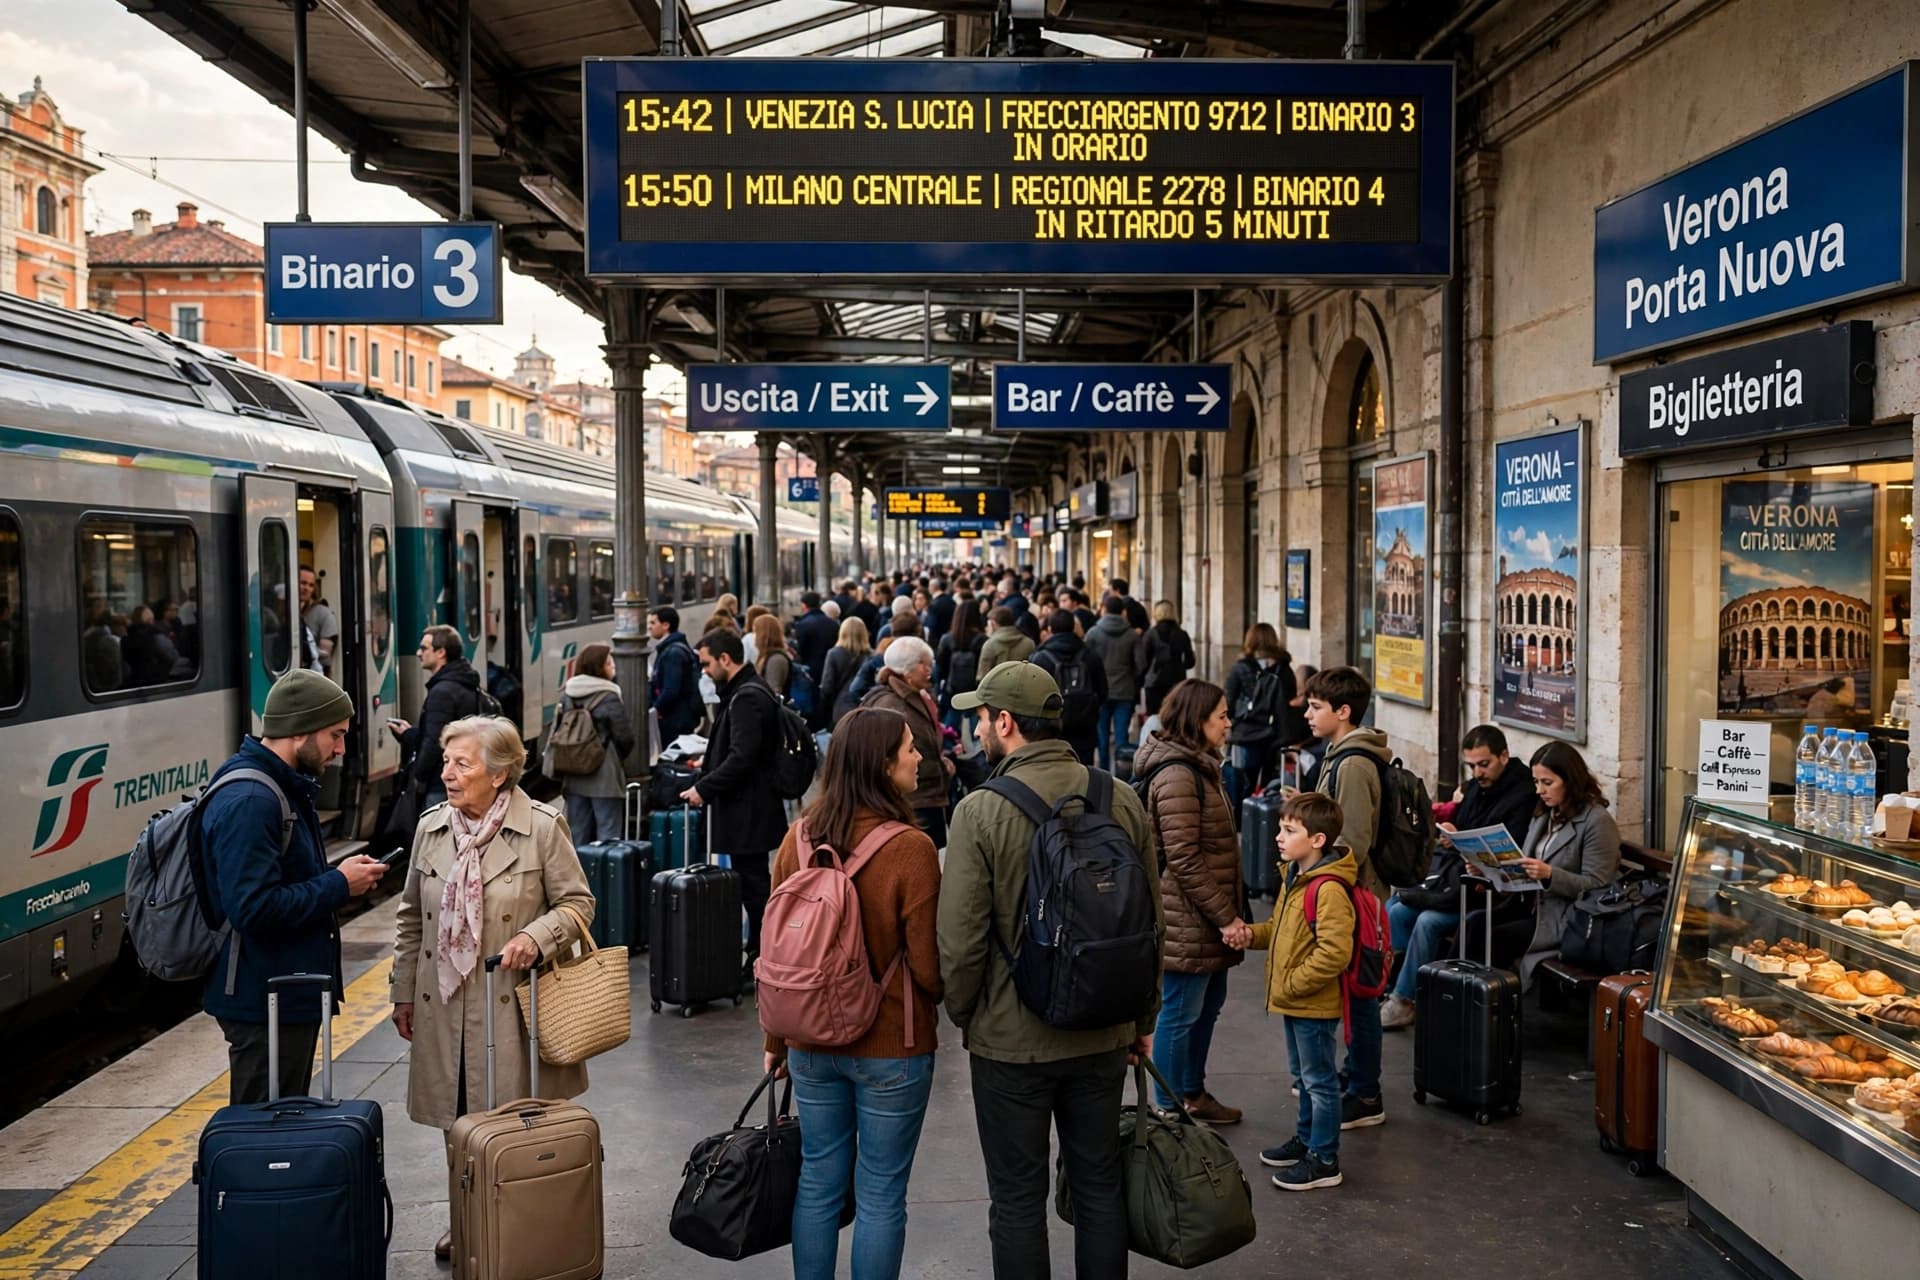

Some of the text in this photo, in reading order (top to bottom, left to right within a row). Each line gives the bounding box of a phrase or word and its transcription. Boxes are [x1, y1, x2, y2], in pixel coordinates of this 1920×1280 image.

[624, 99, 713, 131] 15:42
[746, 100, 855, 129] VENEZIA
[864, 100, 888, 129] S.
[898, 100, 974, 129] LUCIA
[1002, 100, 1199, 131] FRECCIARGENTO
[1208, 102, 1267, 131] 9712
[1292, 102, 1392, 131] BINARIO
[1400, 103, 1415, 132] 3
[1013, 133, 1147, 161] IN ORARIO
[624, 174, 713, 206] 15:50
[746, 175, 843, 205] MILANO
[853, 175, 982, 205] CENTRALE
[1011, 176, 1153, 205] REGIONALE
[1162, 176, 1226, 205] 2278
[1253, 176, 1360, 205] BINARIO
[1368, 176, 1385, 206] 4
[1663, 167, 1789, 251] Verona
[1035, 210, 1330, 239] IN RITARDO 5 MINUTI
[281, 239, 479, 308] Binario 3
[1626, 222, 1845, 329] Porta Nuova
[700, 383, 799, 413] Uscita
[830, 383, 890, 412] Exit
[1008, 383, 1062, 412] Bar
[1092, 382, 1174, 413] Caffè
[1648, 359, 1803, 436] Biglietteria
[1506, 450, 1562, 485] VERONA
[791, 482, 803, 498] 6
[1748, 504, 1840, 528] VERONA
[1740, 529, 1837, 551] CITTÀ DELL'AMORE
[1722, 728, 1746, 742] Bar
[1717, 745, 1752, 760] Caffè
[113, 758, 209, 809] TRENITALIA
[1716, 779, 1748, 792] Panini
